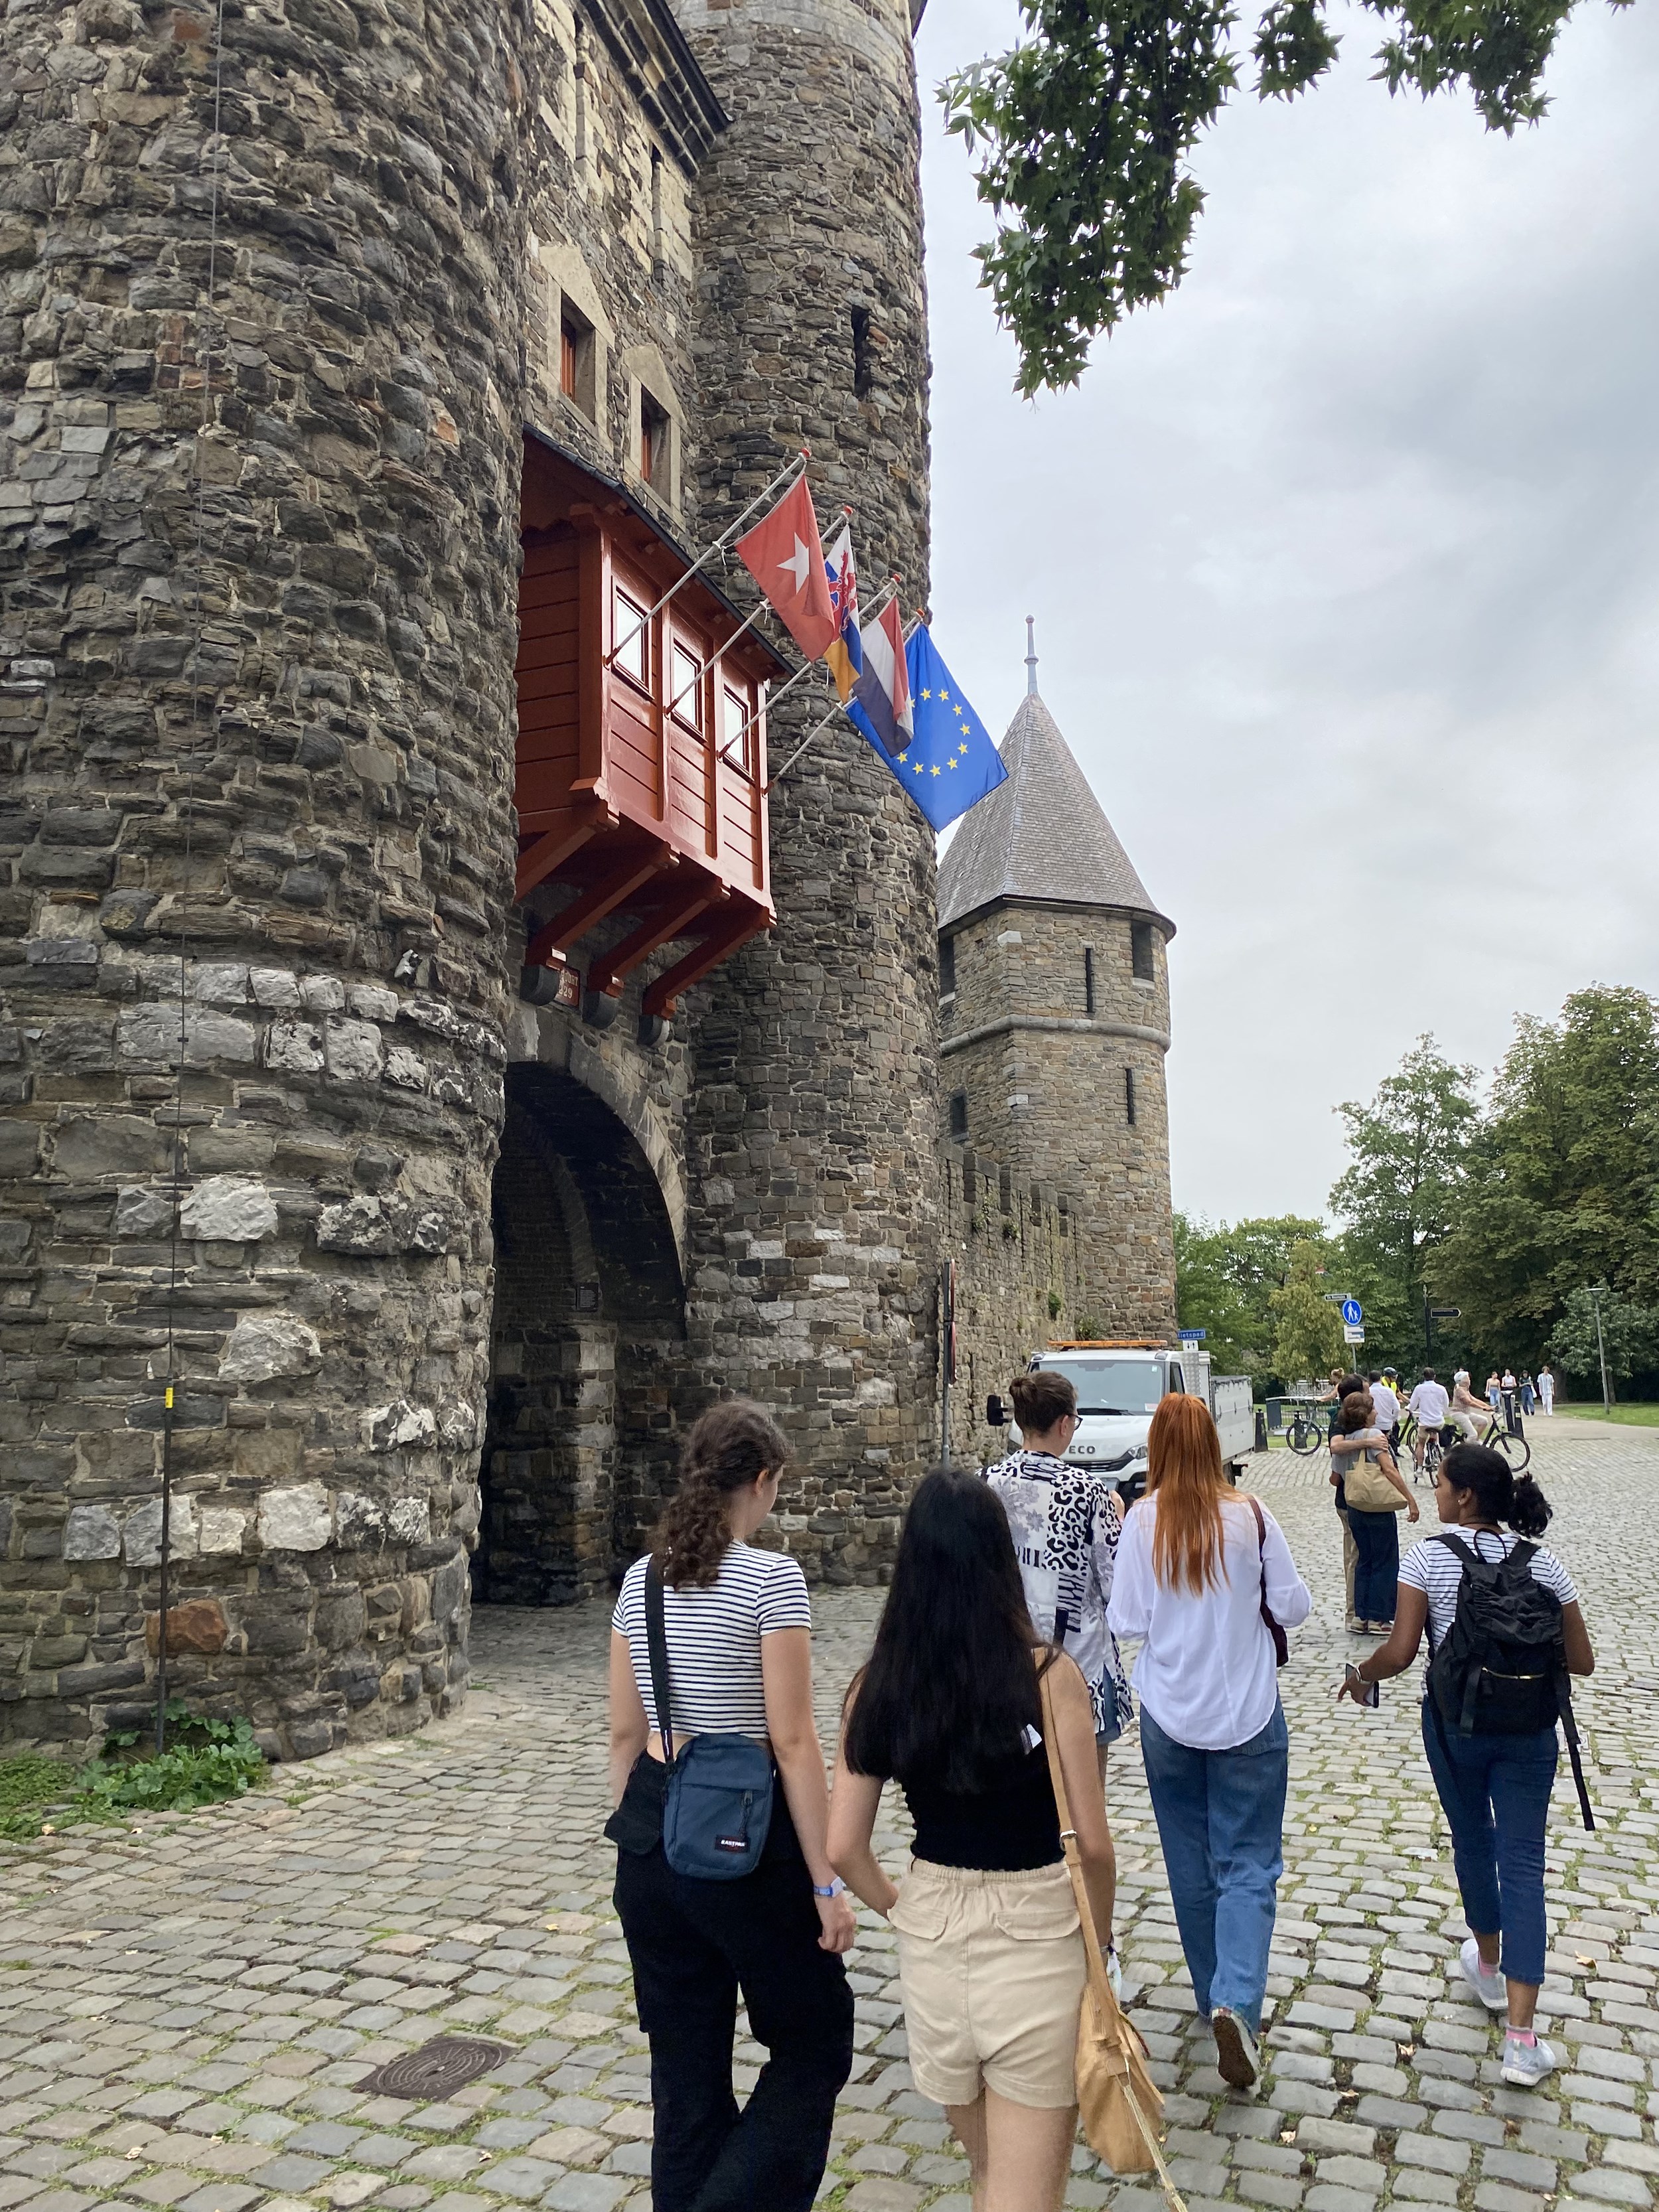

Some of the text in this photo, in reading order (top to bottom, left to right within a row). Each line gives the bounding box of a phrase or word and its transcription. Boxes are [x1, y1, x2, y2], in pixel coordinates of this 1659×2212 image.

[560, 970, 579, 986] POORT
[558, 985, 573, 999] 229
[1068, 1445, 1096, 1454] ECO
